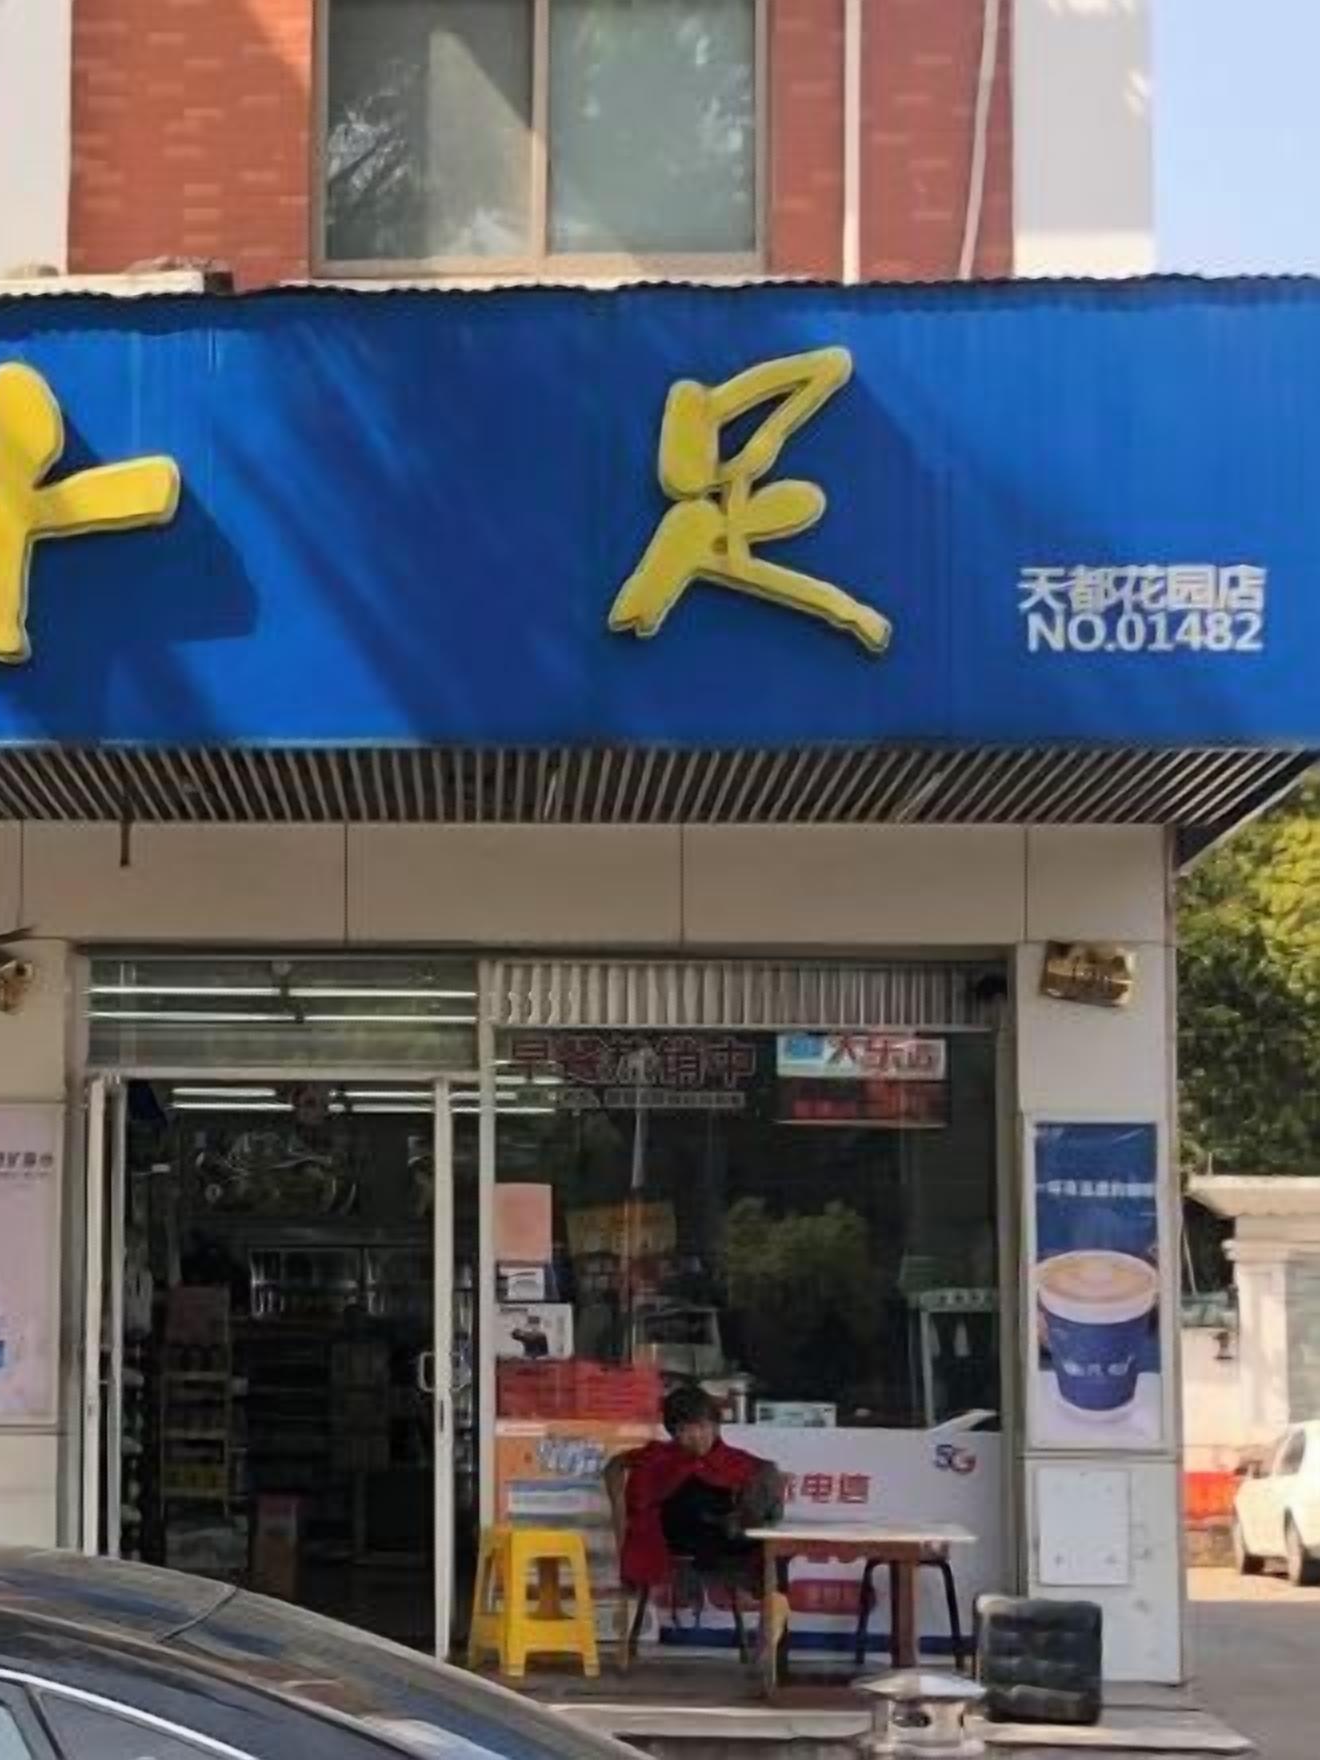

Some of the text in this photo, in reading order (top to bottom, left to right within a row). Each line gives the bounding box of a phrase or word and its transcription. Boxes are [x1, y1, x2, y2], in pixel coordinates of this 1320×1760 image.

[1017, 564, 1268, 612] 天都花园店
[1027, 611, 1265, 652] NO.01482
